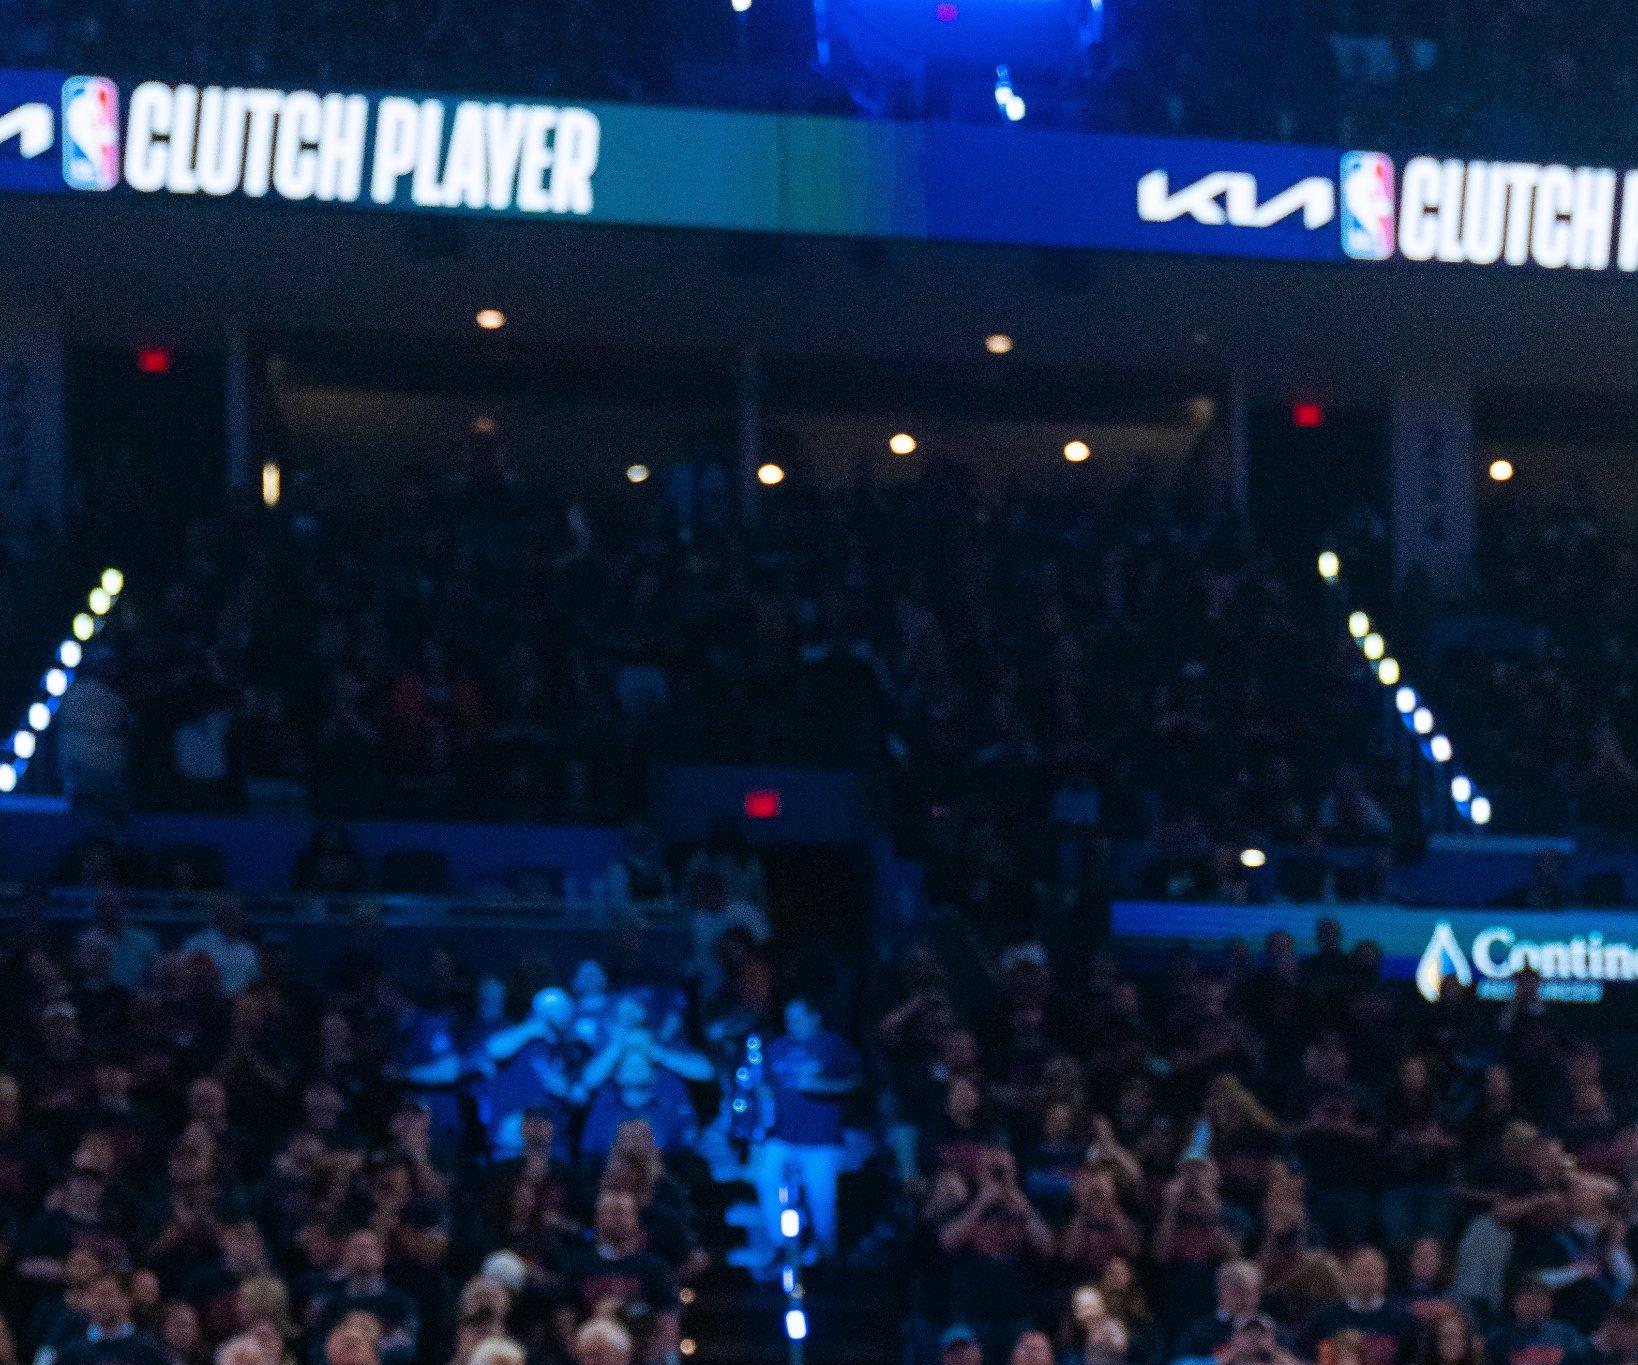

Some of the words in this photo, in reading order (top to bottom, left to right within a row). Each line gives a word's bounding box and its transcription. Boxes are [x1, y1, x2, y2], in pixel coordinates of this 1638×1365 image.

[122, 81, 369, 202] CLUTCH
[371, 97, 600, 214] PLAYER
[1399, 156, 1615, 270] CLUTCH
